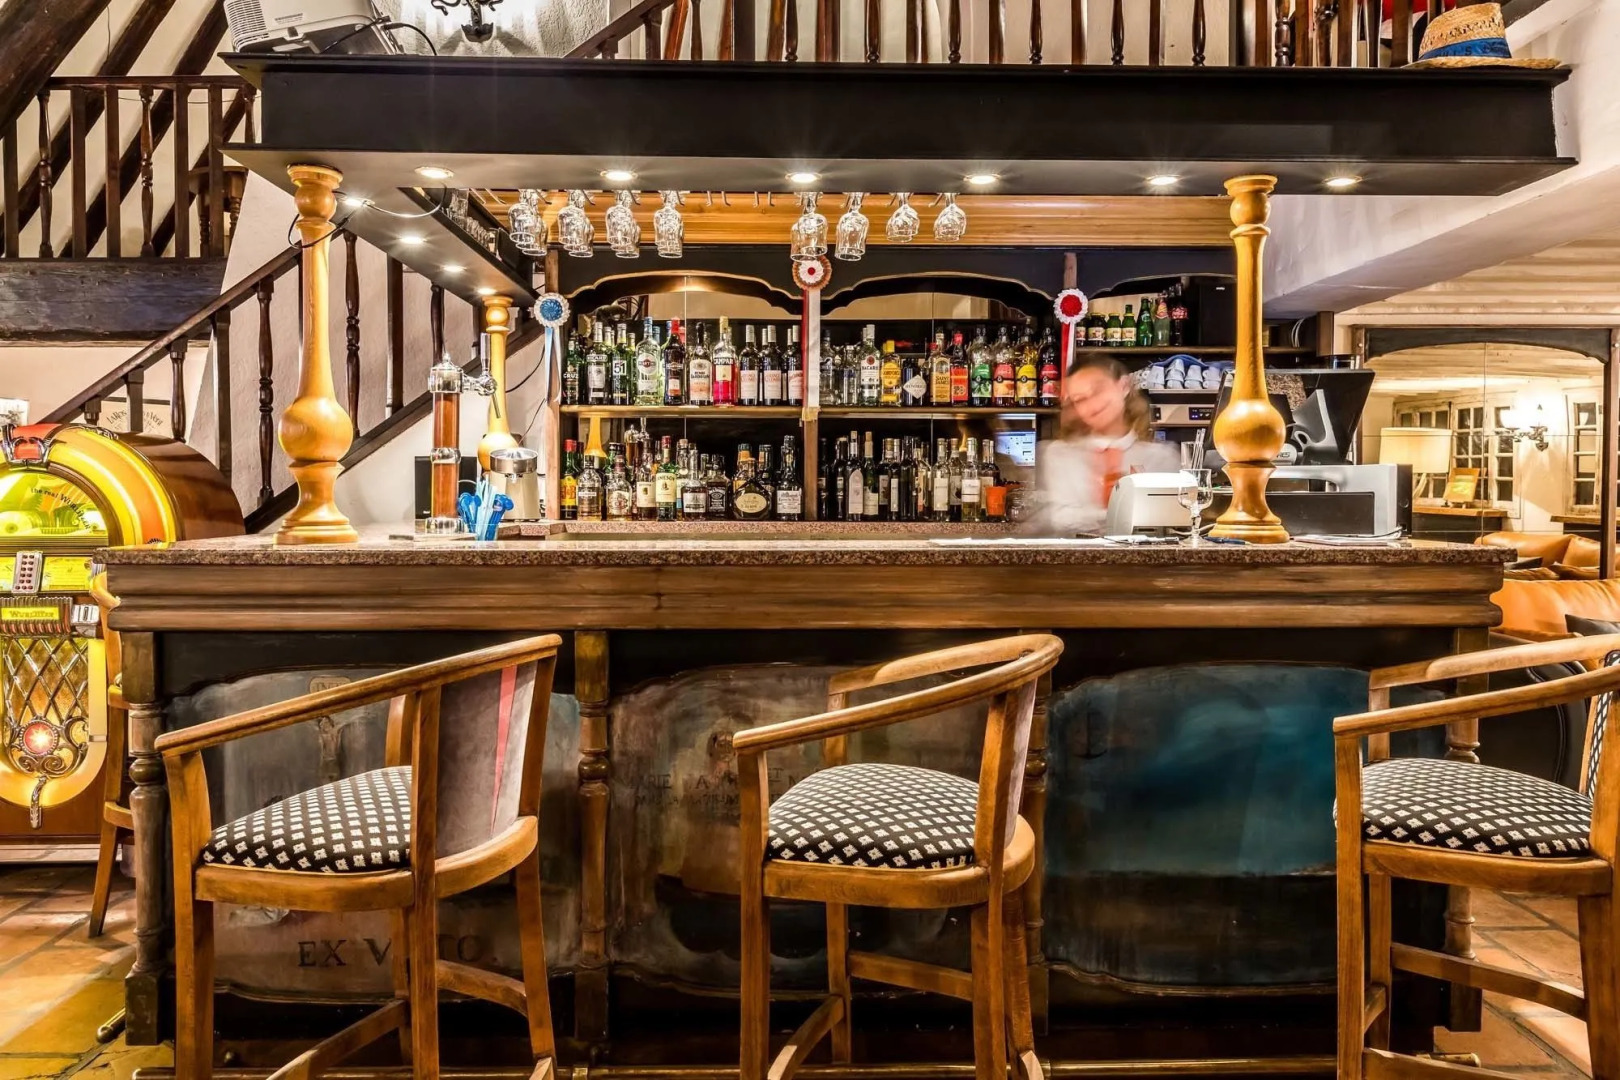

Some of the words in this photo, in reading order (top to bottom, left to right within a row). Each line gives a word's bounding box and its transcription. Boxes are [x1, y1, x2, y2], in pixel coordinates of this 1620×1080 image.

[613, 361, 626, 374] 51
[298, 939, 347, 967] EX
[363, 933, 498, 967] VTO.
